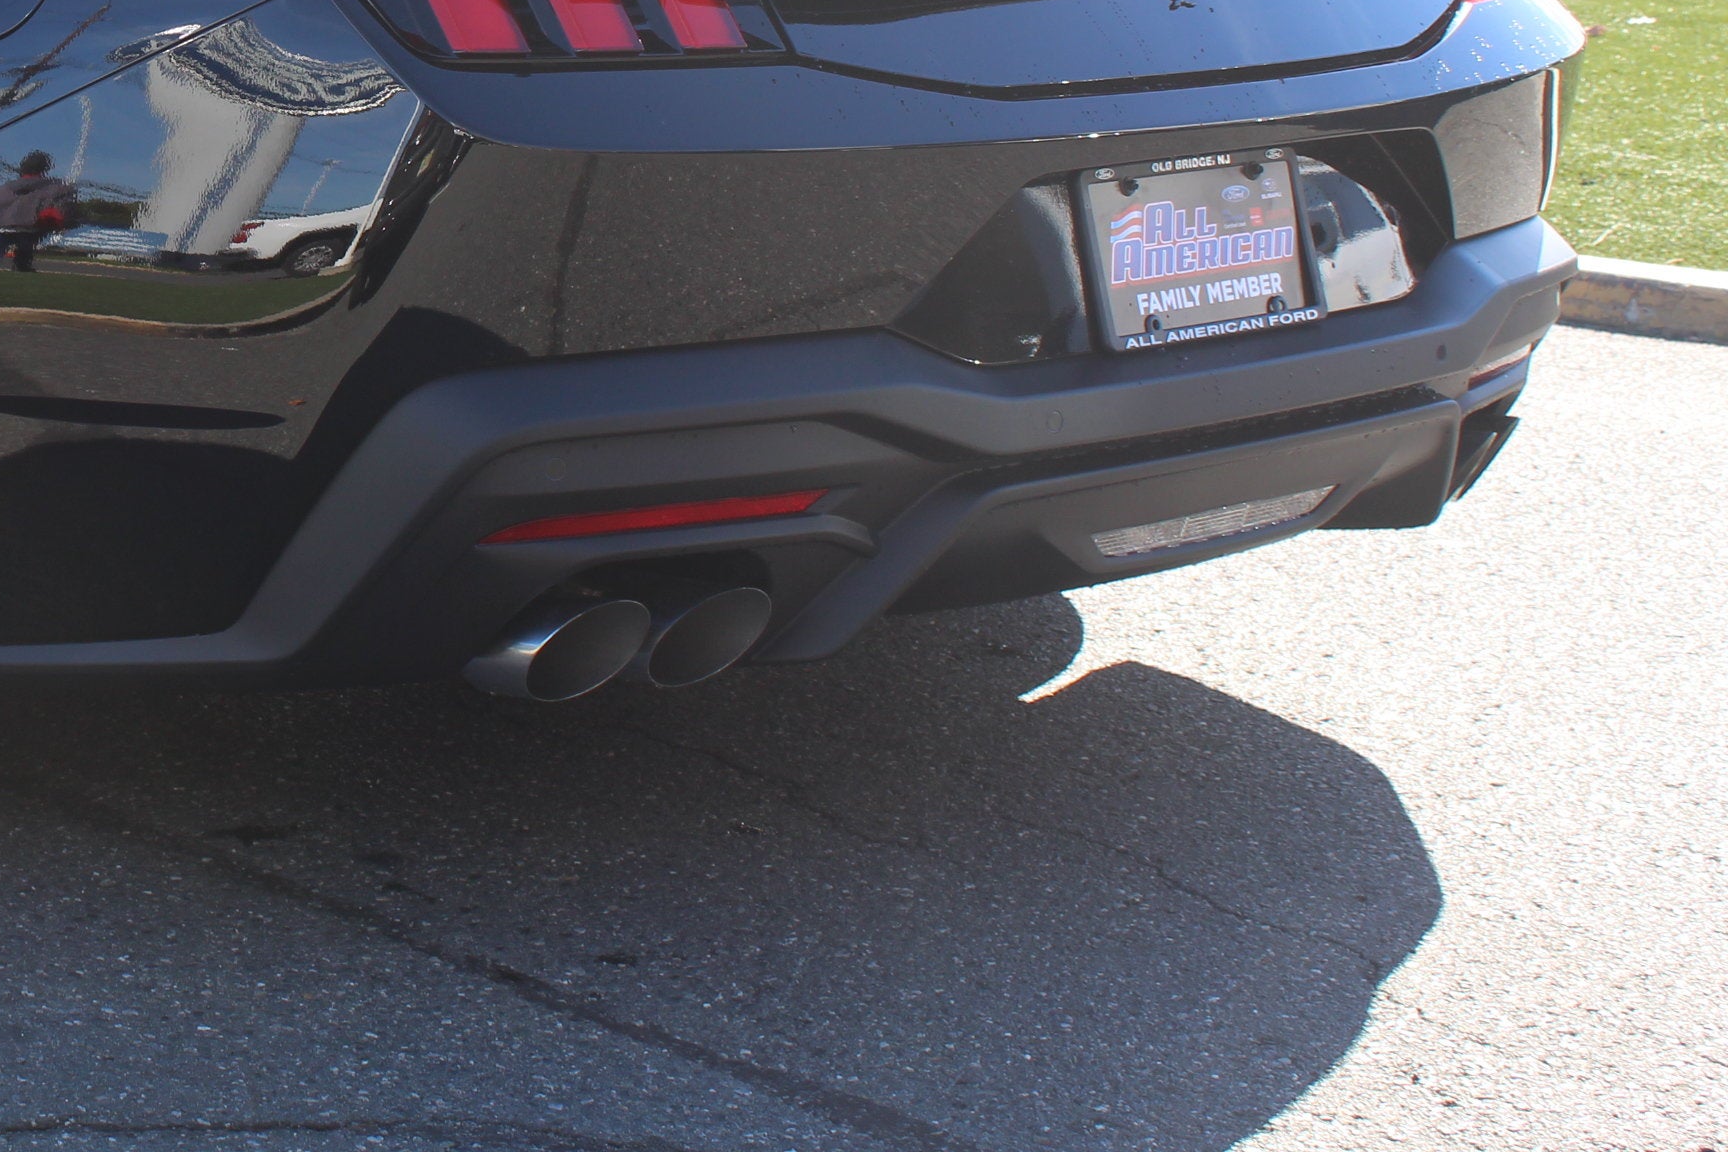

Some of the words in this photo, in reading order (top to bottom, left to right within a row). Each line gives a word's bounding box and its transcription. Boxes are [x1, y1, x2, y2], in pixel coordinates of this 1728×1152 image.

[1151, 162, 1172, 173] OLD
[1217, 153, 1231, 165] NJ
[1112, 226, 1294, 284] AMERICAN
[1137, 284, 1201, 316] FAMILY
[1206, 272, 1283, 304] MEMBER
[1125, 334, 1162, 349] ALL
[1166, 317, 1264, 343] AMERICAN
[1268, 309, 1319, 326] FORD
